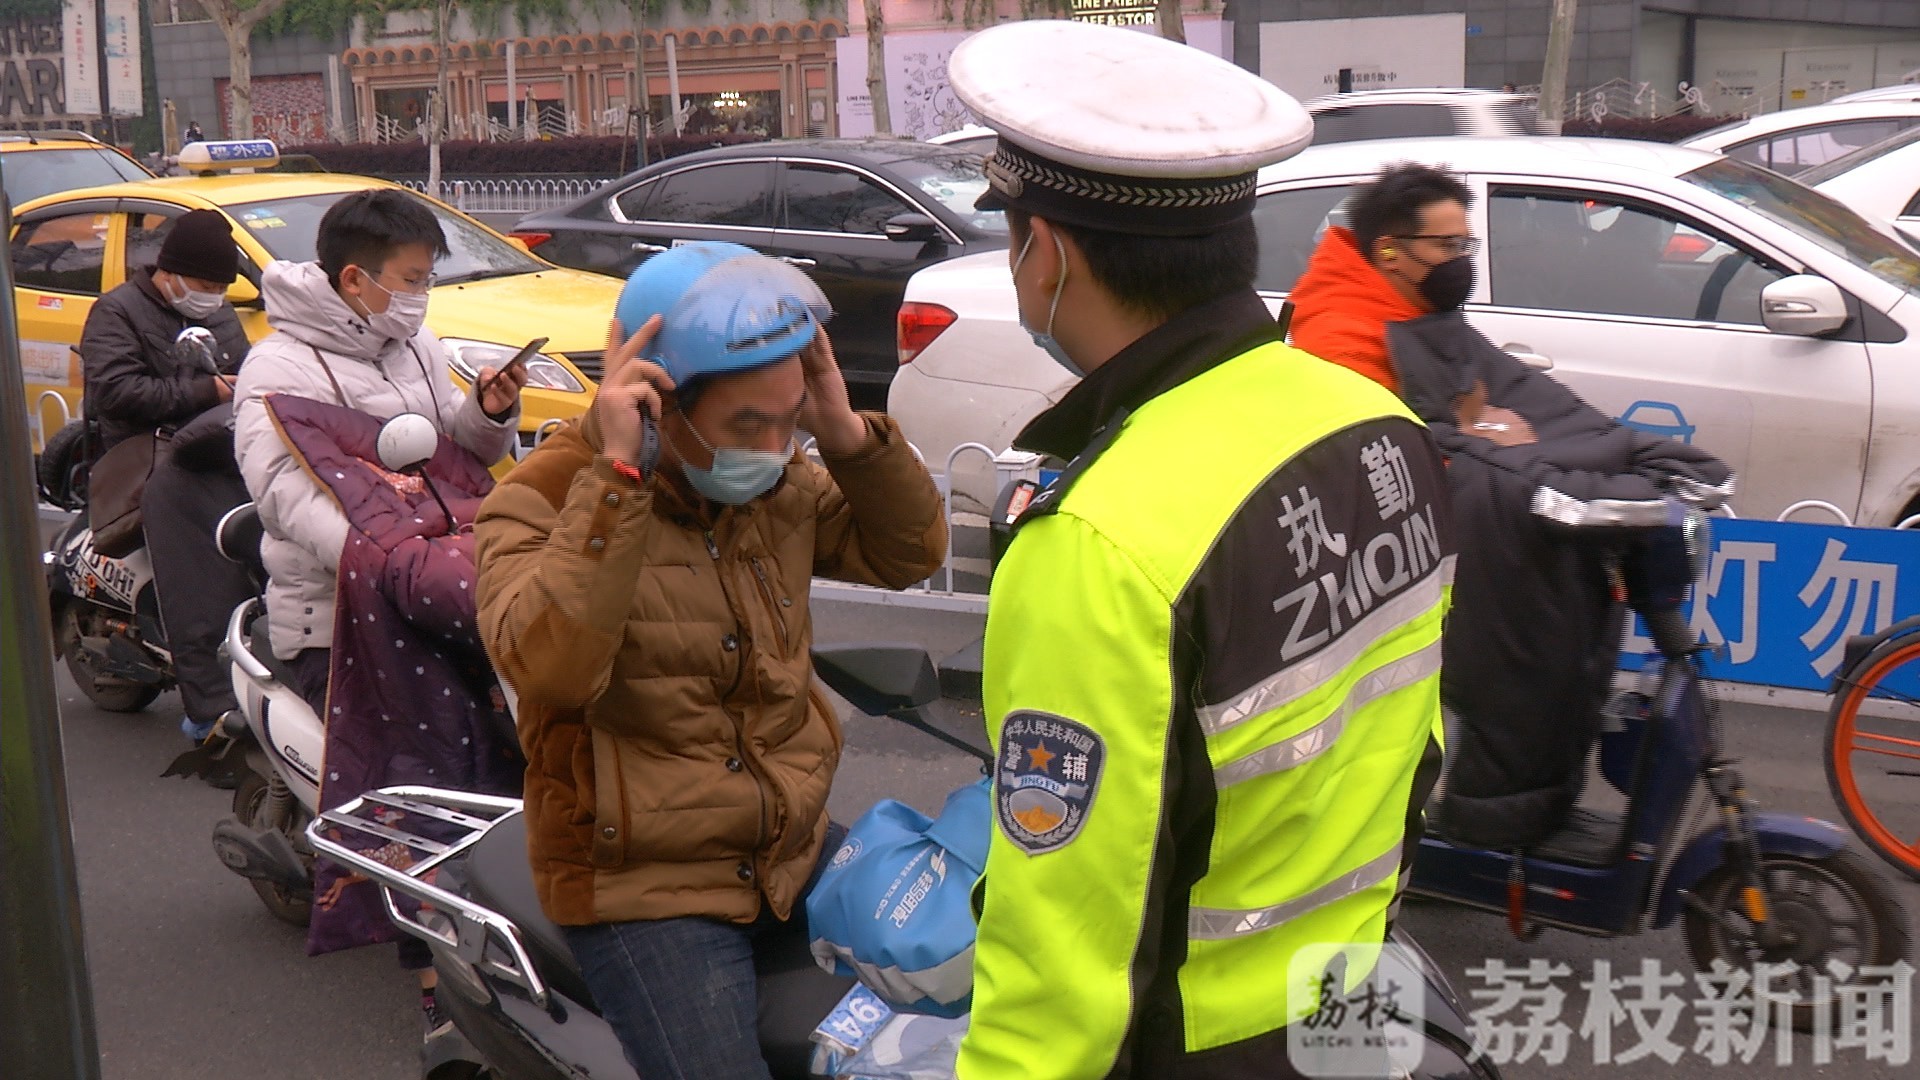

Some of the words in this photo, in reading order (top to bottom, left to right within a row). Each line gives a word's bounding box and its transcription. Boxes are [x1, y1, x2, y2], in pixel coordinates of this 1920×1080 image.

[1277, 435, 1416, 578] 执勤
[1273, 503, 1441, 662] ZHIQIN
[1005, 719, 1095, 754] 中华人民共和国
[832, 996, 881, 1040] 94
